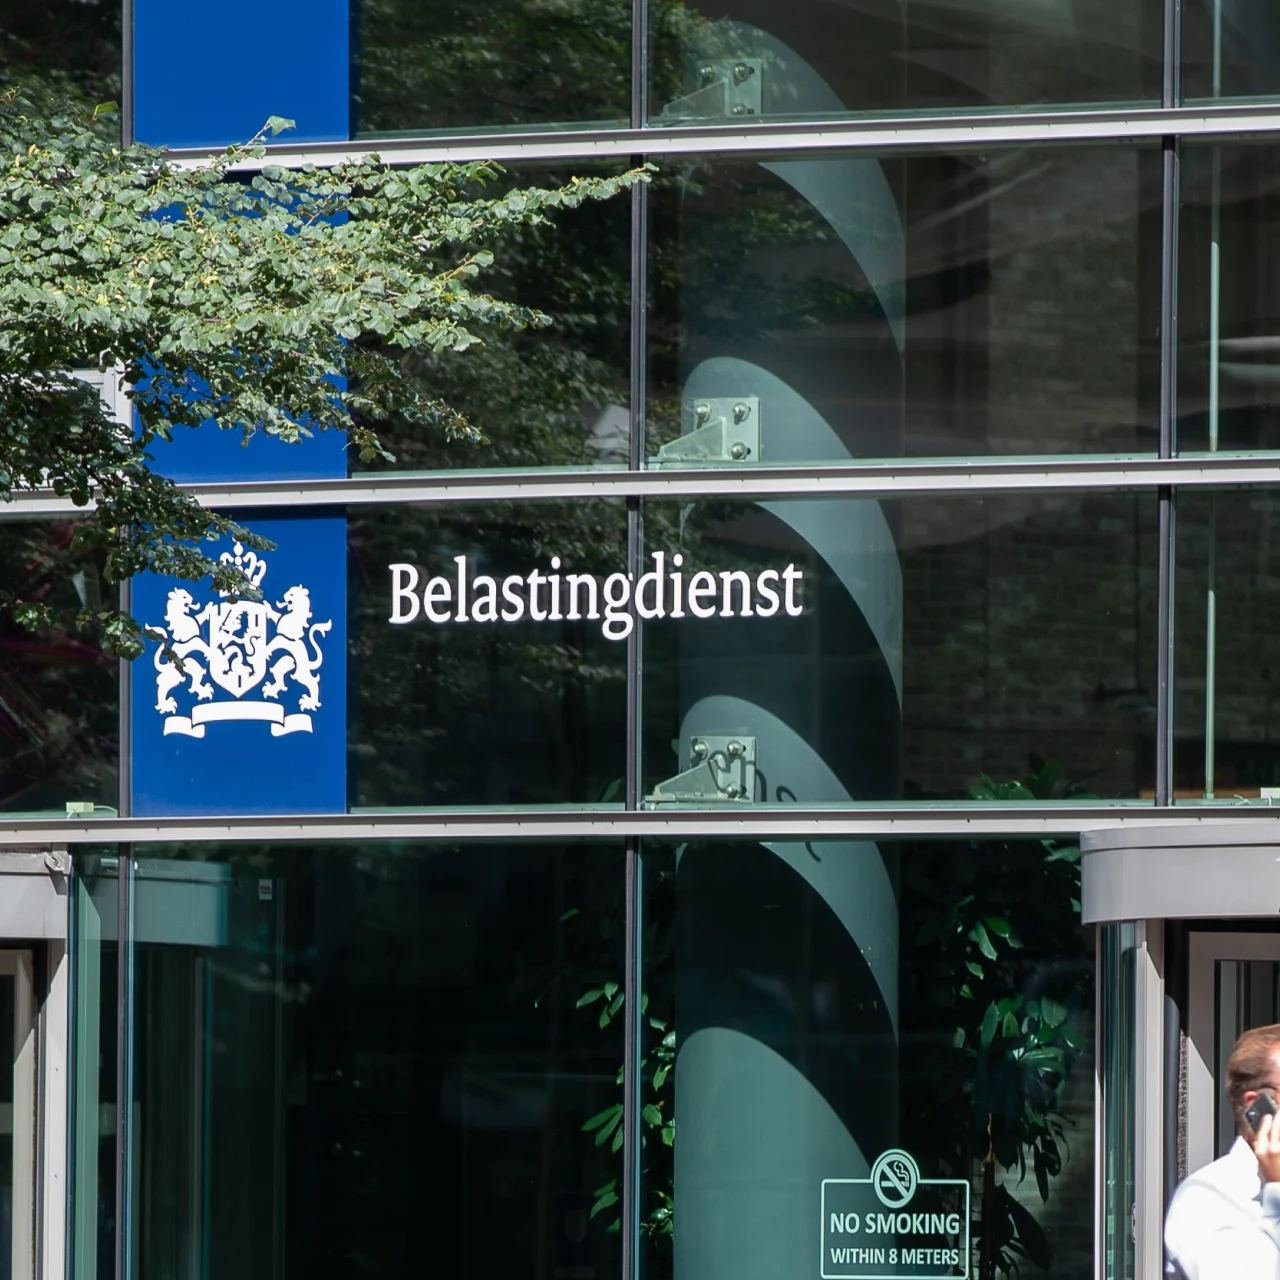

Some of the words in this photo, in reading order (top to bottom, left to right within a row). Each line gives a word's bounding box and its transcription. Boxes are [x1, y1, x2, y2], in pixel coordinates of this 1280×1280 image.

[388, 551, 804, 642] Belastingdienst
[830, 1213, 860, 1234] NO
[865, 1213, 960, 1235] SMOKING
[830, 1248, 885, 1264] WITHIN
[888, 1248, 898, 1264] 8
[901, 1249, 959, 1265] METERS
